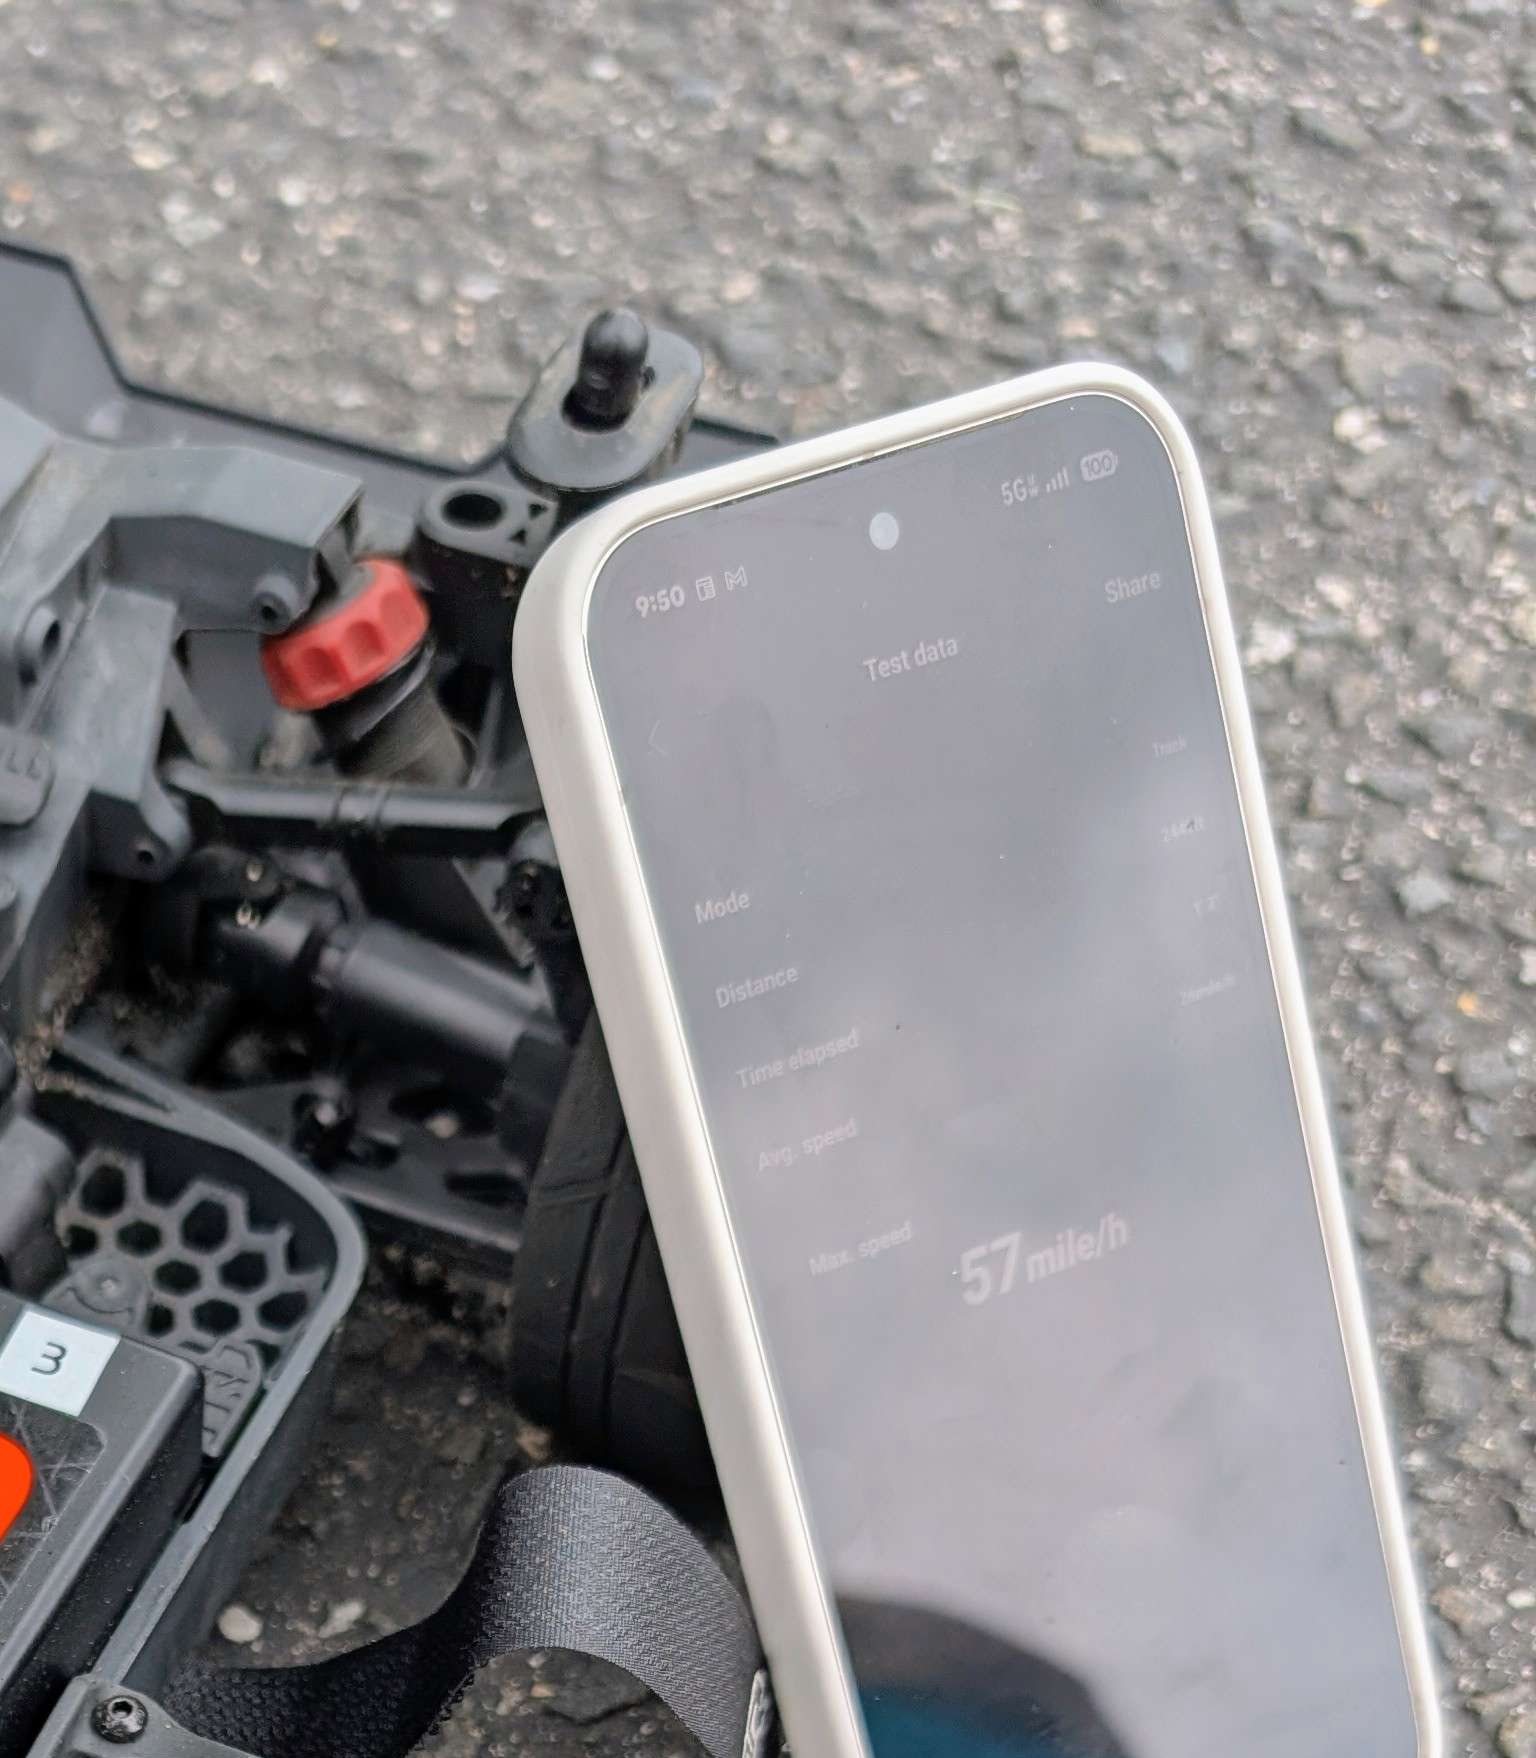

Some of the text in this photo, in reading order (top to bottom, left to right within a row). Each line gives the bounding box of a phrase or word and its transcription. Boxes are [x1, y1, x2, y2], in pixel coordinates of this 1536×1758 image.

[635, 585, 685, 618] 9:50
[1104, 572, 1161, 602] Share
[864, 635, 958, 682] Test data
[694, 889, 750, 924] Mode
[715, 964, 799, 1008] Distance
[736, 1028, 861, 1089] Time elapsed
[802, 1117, 858, 1158] speed
[861, 1220, 913, 1263] speed
